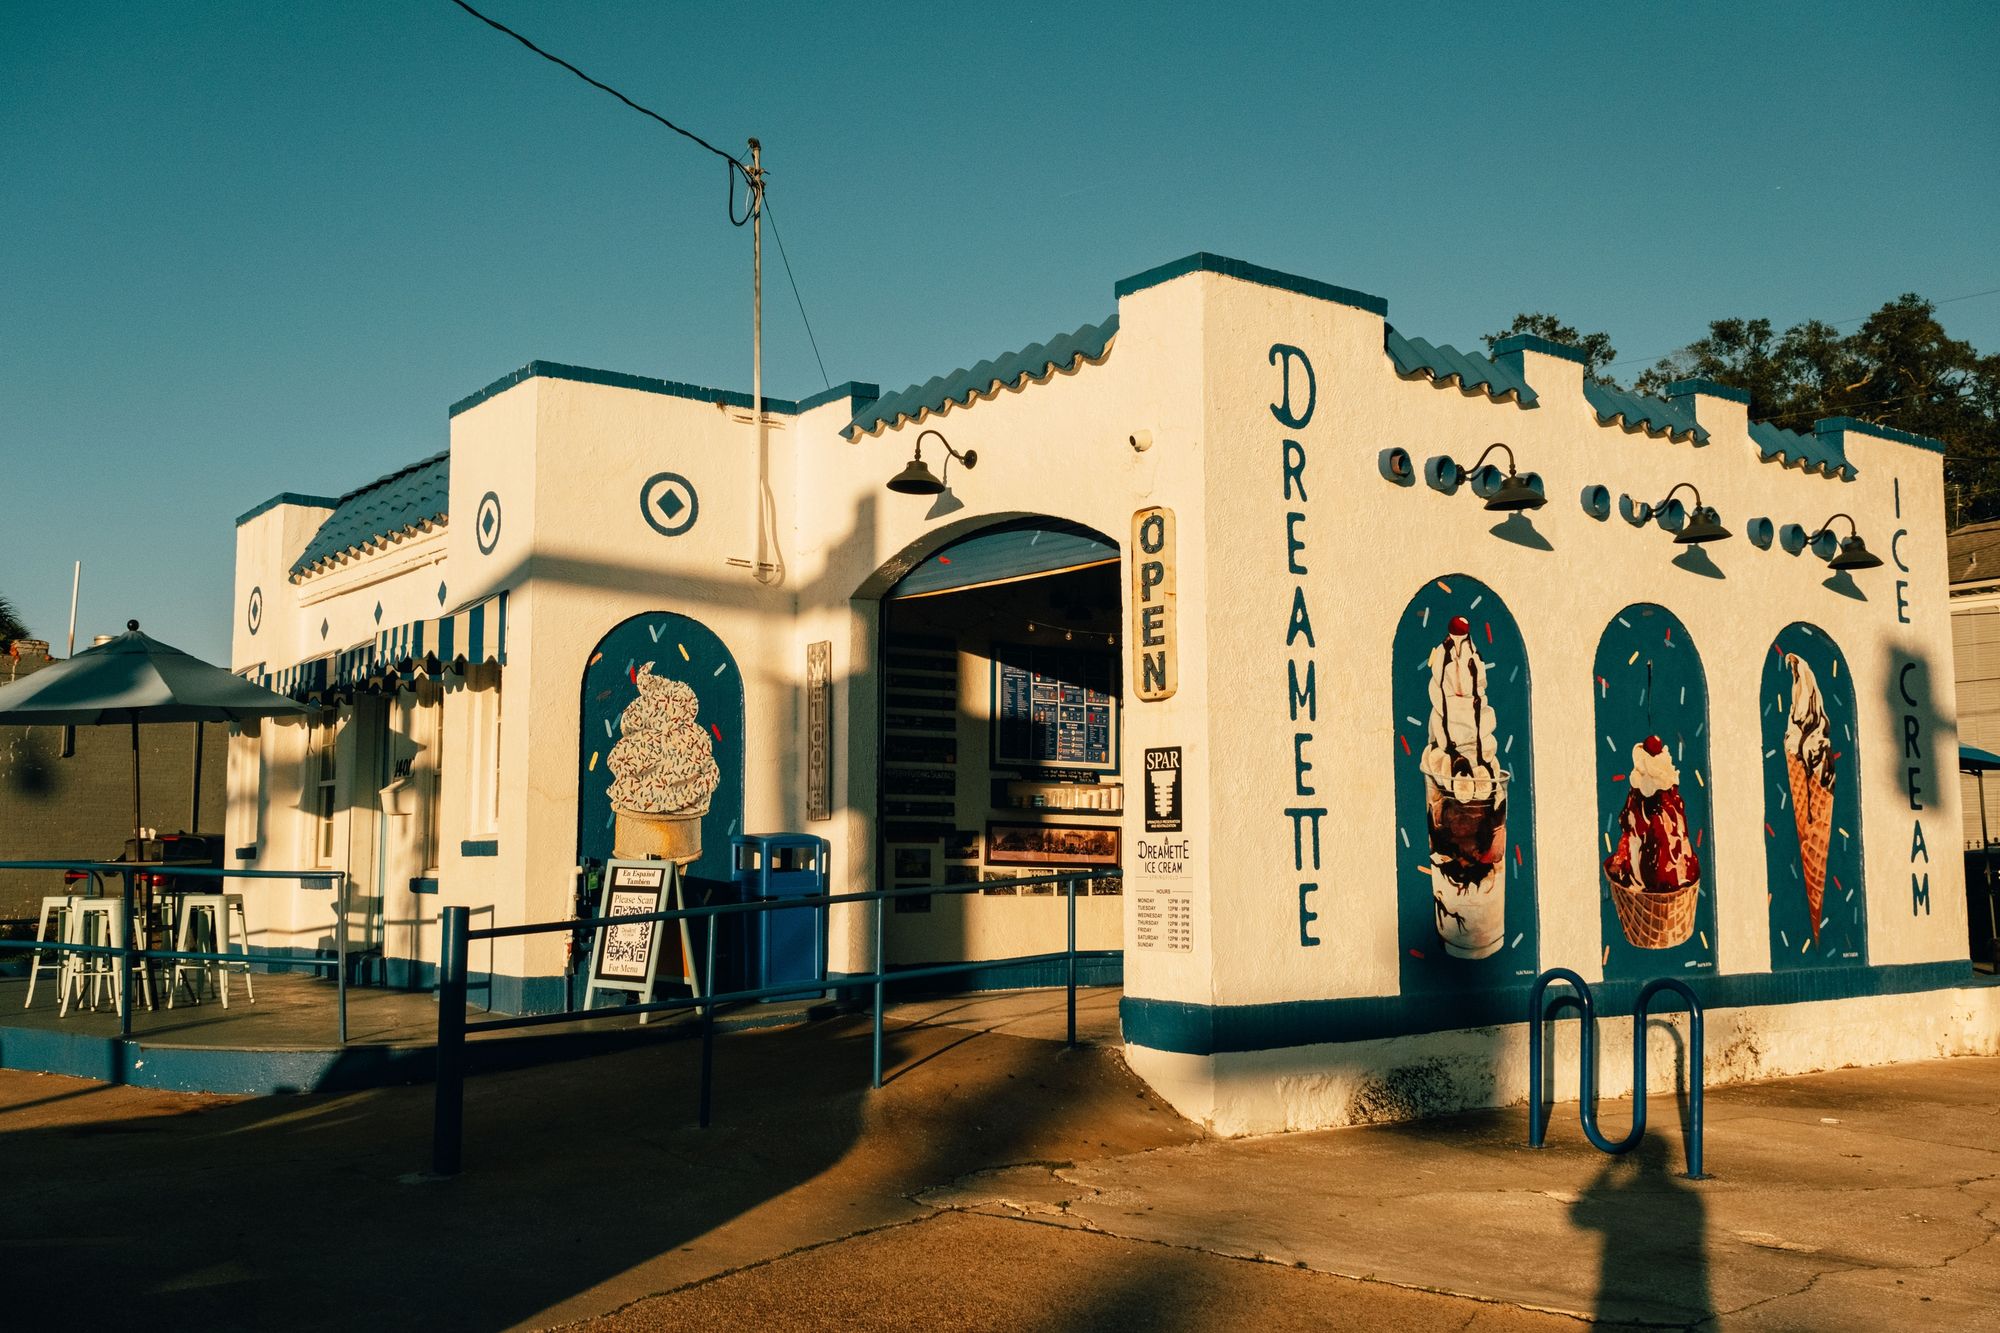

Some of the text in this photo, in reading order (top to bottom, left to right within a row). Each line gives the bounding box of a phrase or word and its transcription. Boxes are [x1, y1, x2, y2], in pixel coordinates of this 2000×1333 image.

[1140, 514, 1166, 693] OPEN
[1269, 343, 1328, 947] DREAMETTE
[1891, 477, 1931, 917] ICE CREAM
[394, 758, 412, 777] 1401
[1146, 751, 1180, 770] SPAR
[1138, 840, 1190, 859] DREAMETTE
[633, 870, 656, 878] Español
[1145, 861, 1182, 874] ICE CREAM
[614, 894, 654, 905] Please Scan
[608, 963, 638, 974] For Menu
